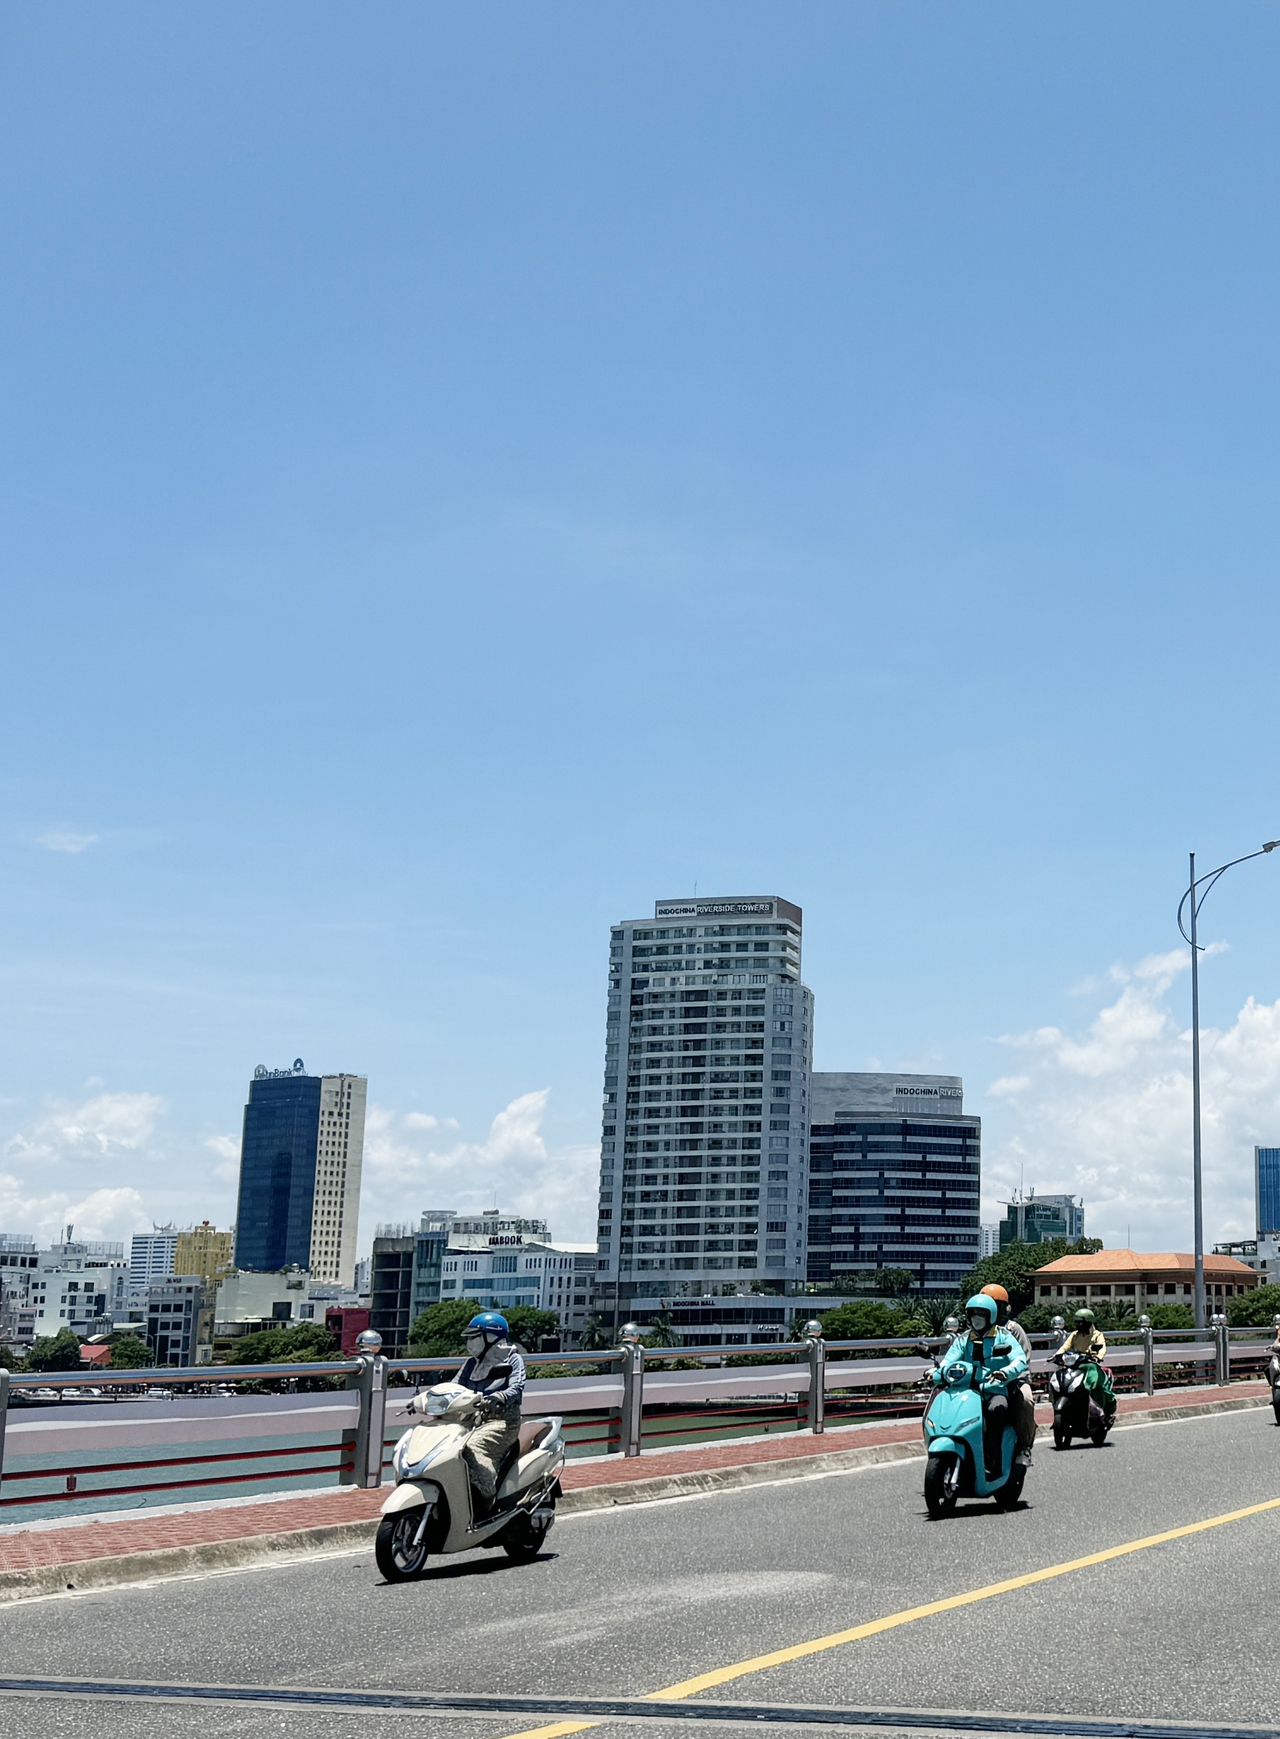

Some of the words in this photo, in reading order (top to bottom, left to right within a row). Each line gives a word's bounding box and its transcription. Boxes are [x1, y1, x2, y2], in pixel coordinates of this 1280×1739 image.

[658, 907, 696, 916] INDOCHINA
[697, 904, 736, 914] RIVERSIDE
[737, 904, 770, 912] TOWERS
[895, 1087, 938, 1096] INDOCHINA
